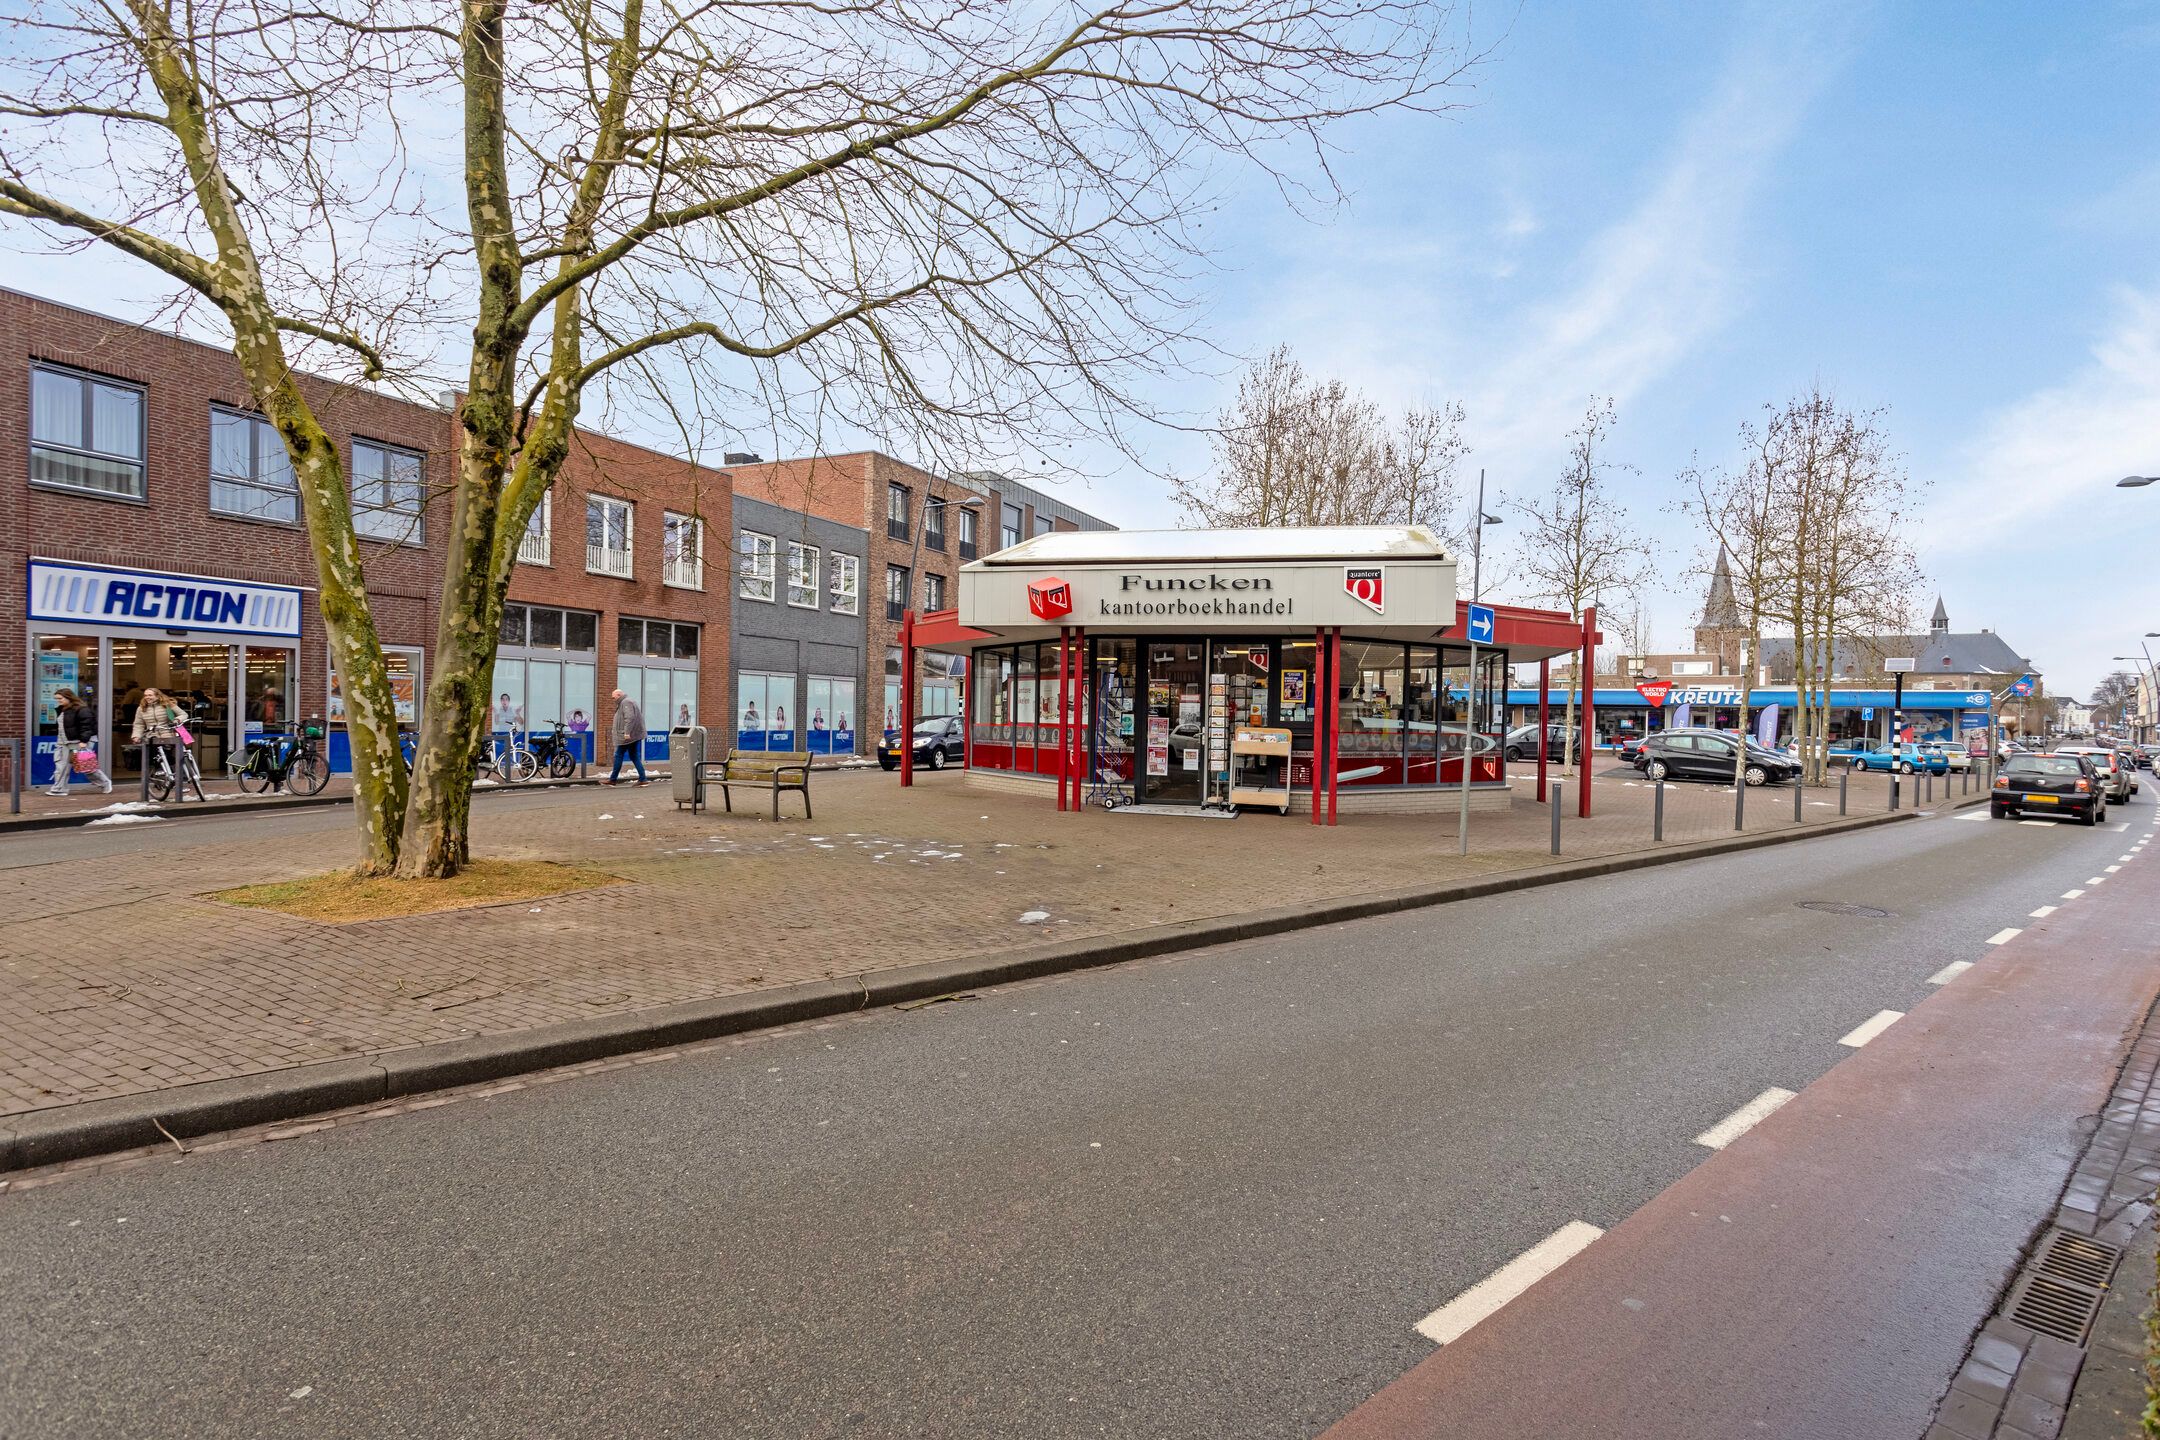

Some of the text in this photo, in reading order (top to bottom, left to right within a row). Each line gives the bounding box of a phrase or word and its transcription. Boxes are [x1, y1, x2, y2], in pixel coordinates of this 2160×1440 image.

[1119, 574, 1274, 591] Funcken
[103, 580, 248, 625] ACTION
[1100, 598, 1293, 616] kantoorboekhandel
[1670, 691, 1744, 704] KREUTZ
[646, 734, 667, 743] ACTION
